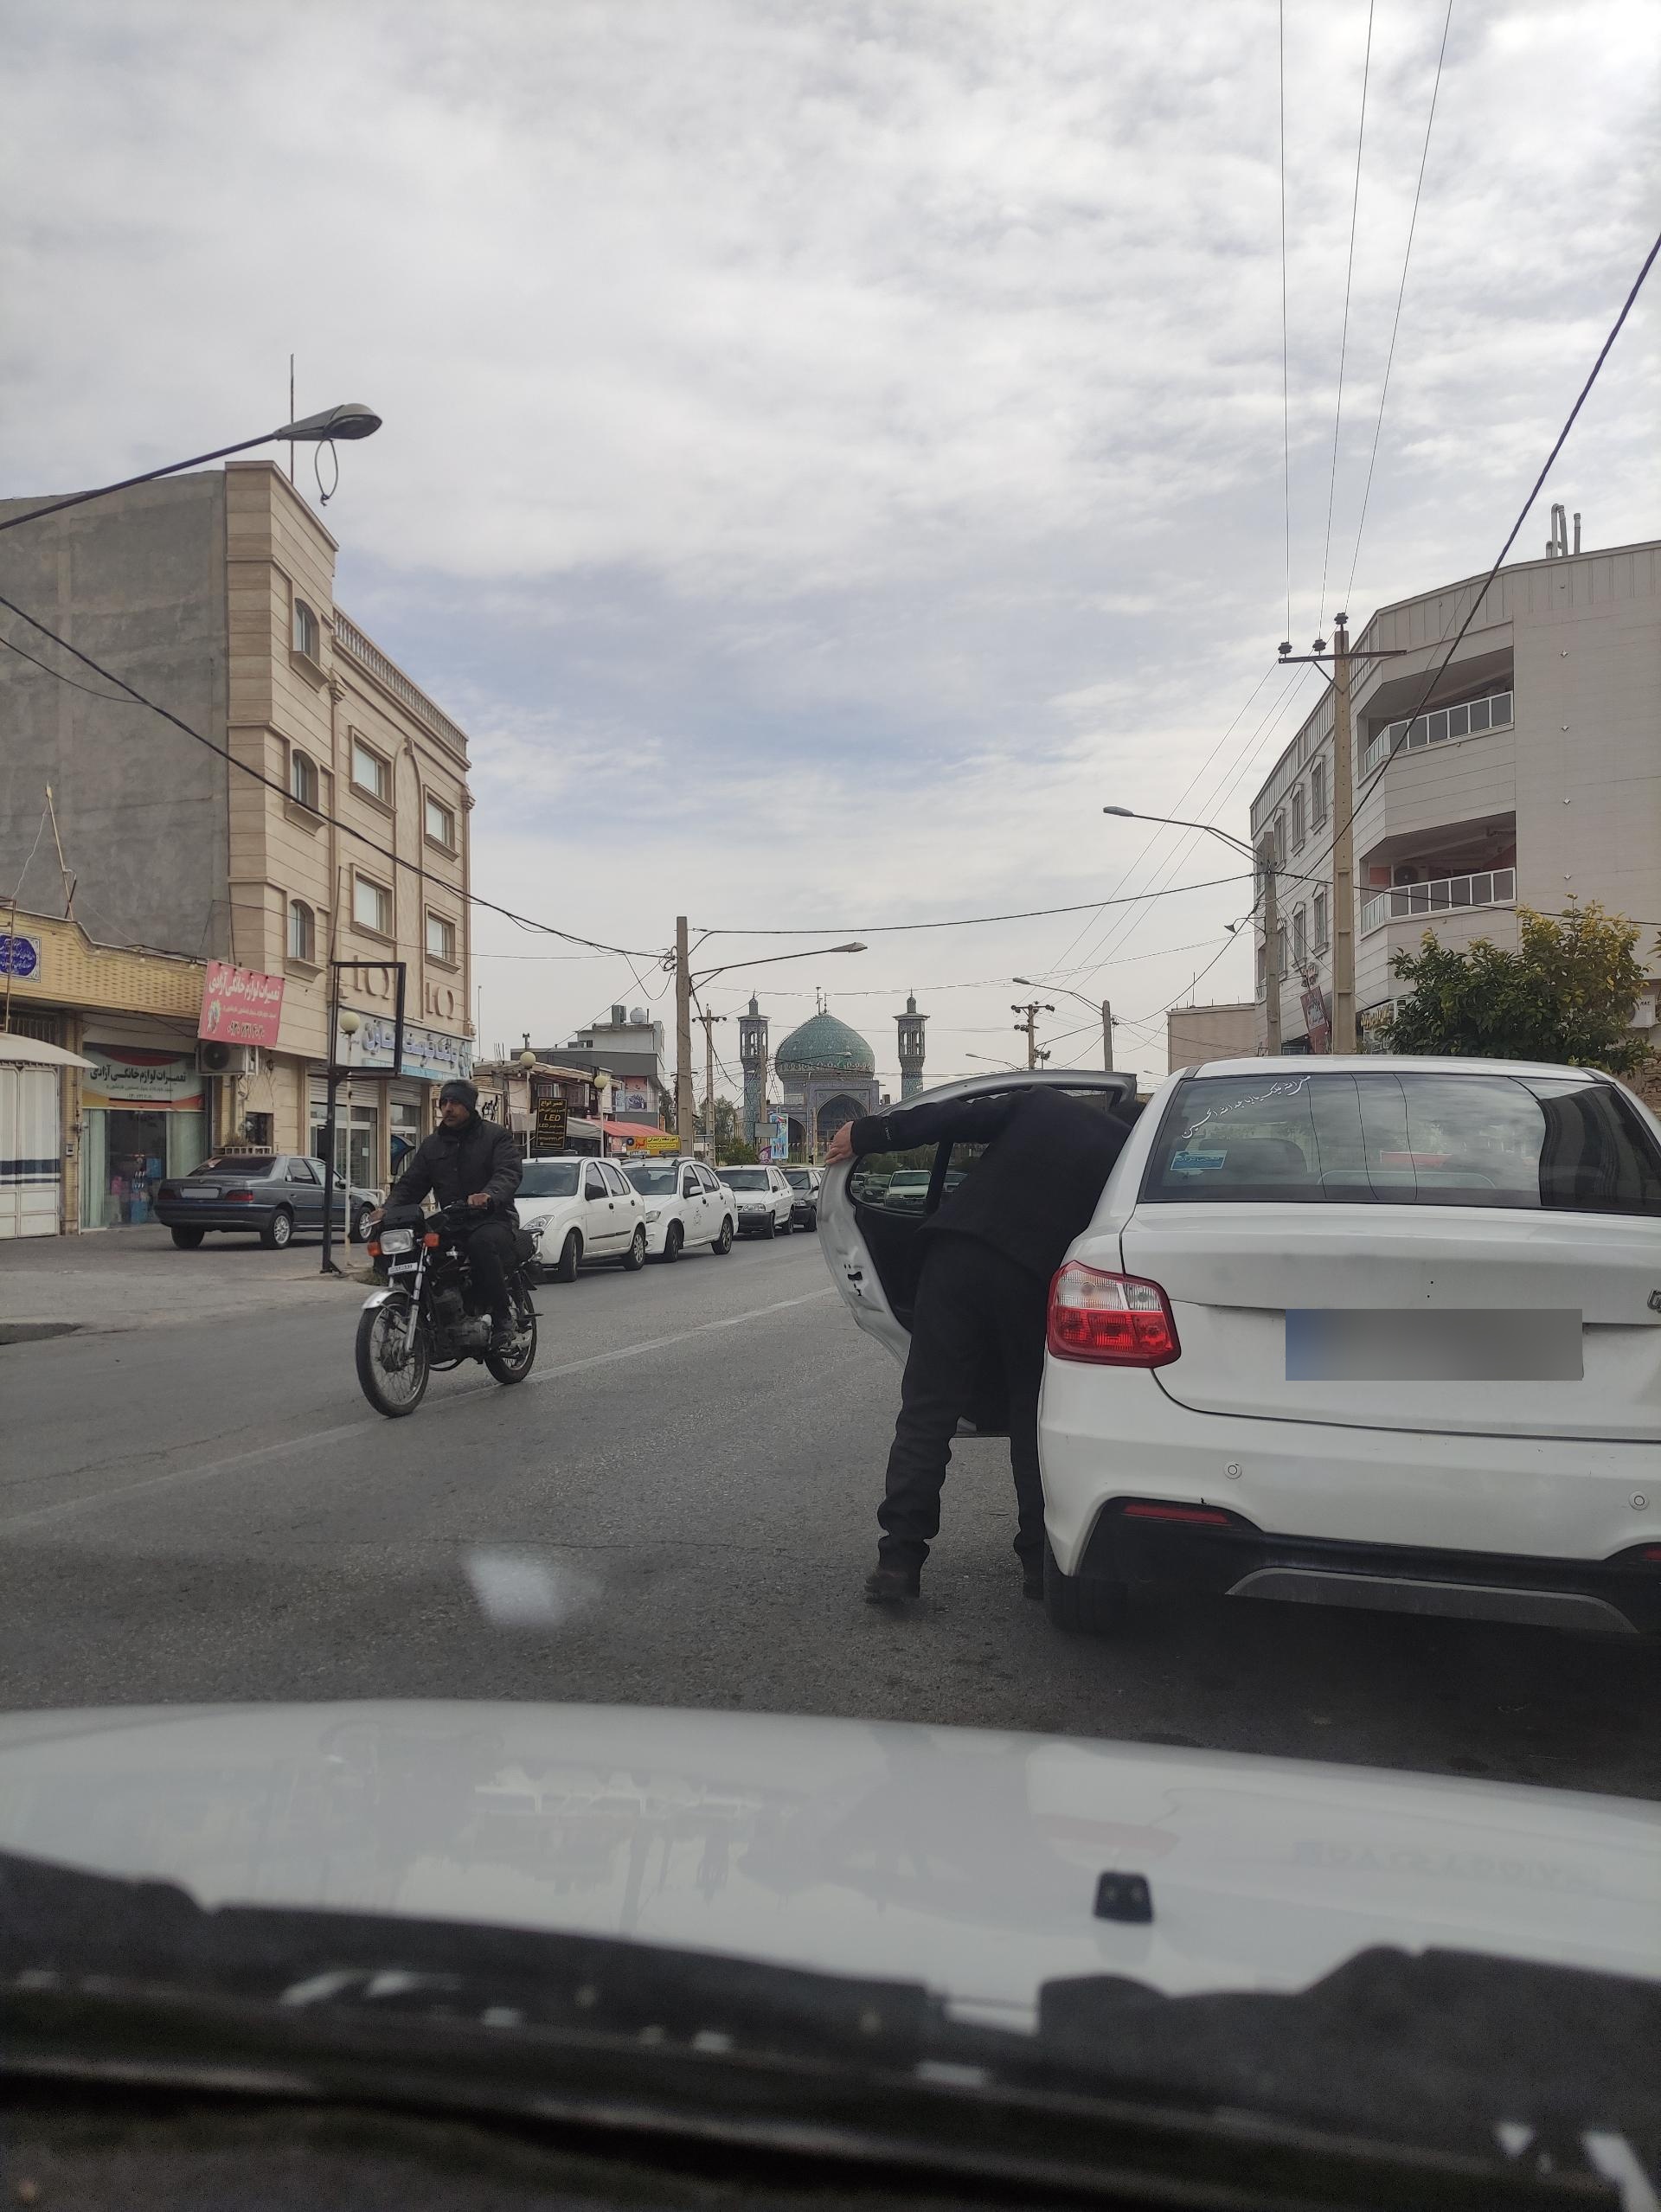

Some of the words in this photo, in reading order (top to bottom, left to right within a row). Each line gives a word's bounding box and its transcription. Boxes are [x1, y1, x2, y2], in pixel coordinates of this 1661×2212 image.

[90, 1065, 111, 1080] آزادی
[111, 1067, 139, 1081] خانگی
[139, 1068, 157, 1084] لوازم
